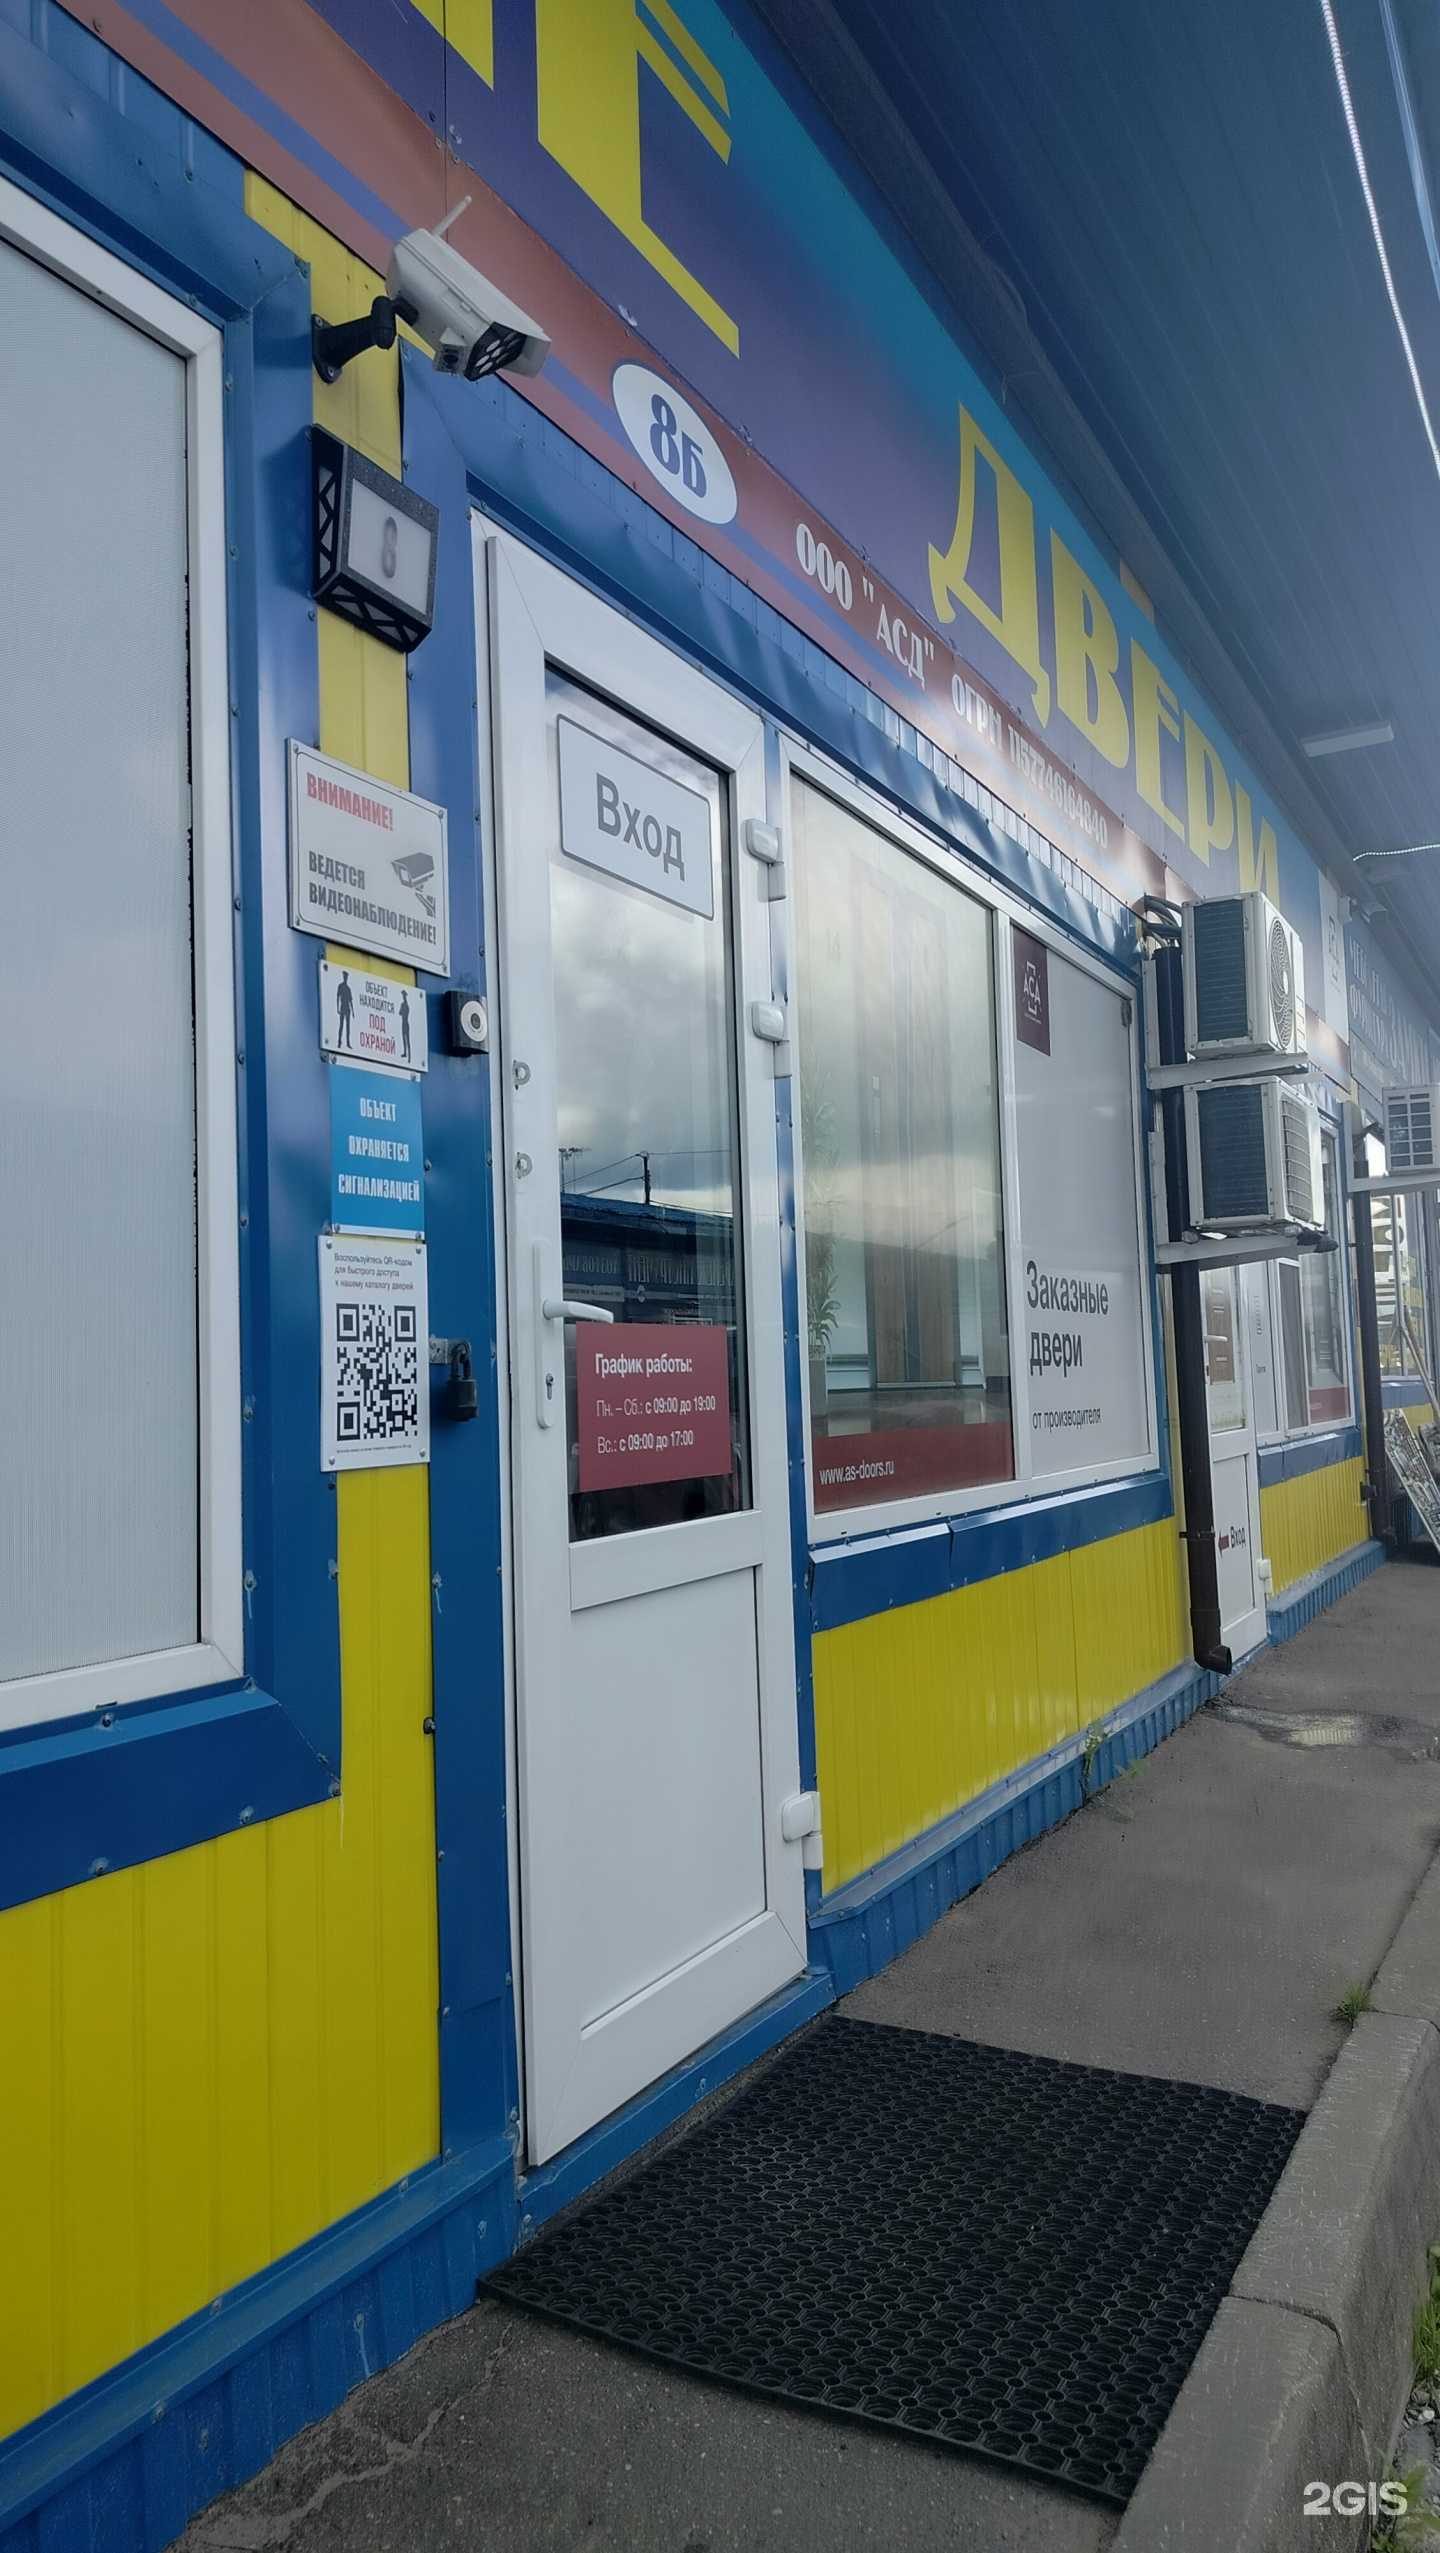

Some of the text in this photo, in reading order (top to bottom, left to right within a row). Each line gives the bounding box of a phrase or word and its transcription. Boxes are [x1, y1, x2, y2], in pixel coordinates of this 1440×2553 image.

[649, 394, 707, 499] 8Б
[796, 523, 853, 610] ООО
[929, 401, 1281, 908] ДВЕРИ
[306, 772, 394, 832] ВНИМАНИЕ!
[596, 772, 686, 882] Вход
[308, 851, 366, 890] ВЕДЕТСЯ
[308, 882, 437, 945] ВИДЕОНАБЛЮДЕНИЕ!
[365, 981, 388, 998] ОБЪЕКТ
[359, 994, 395, 1014] НАХОДИТСЯ
[369, 1014, 386, 1033] ПОД
[359, 1031, 396, 1055] ОХРАНОЙ
[359, 1097, 397, 1123] ОБЪЕКТ
[348, 1135, 410, 1163] ОХРАНЯЕТСЯ
[338, 1173, 420, 1202] СИГНАЛИЗАЦИЕЙ
[1027, 1260, 1109, 1315] Заказные
[595, 1353, 693, 1378] График работы:
[1030, 1332, 1083, 1378] двери
[596, 1400, 614, 1416] Пн.
[645, 1401, 652, 1414] с
[653, 1397, 678, 1413] 09:00
[680, 1400, 691, 1415] до
[694, 1396, 716, 1411] 19:00
[1032, 1408, 1101, 1432] от производителя
[597, 1430, 694, 1453] Вс.: с 09:00 до 17:00
[819, 1460, 895, 1485] www.as-doors.ru
[1230, 1526, 1246, 1549] Вход
